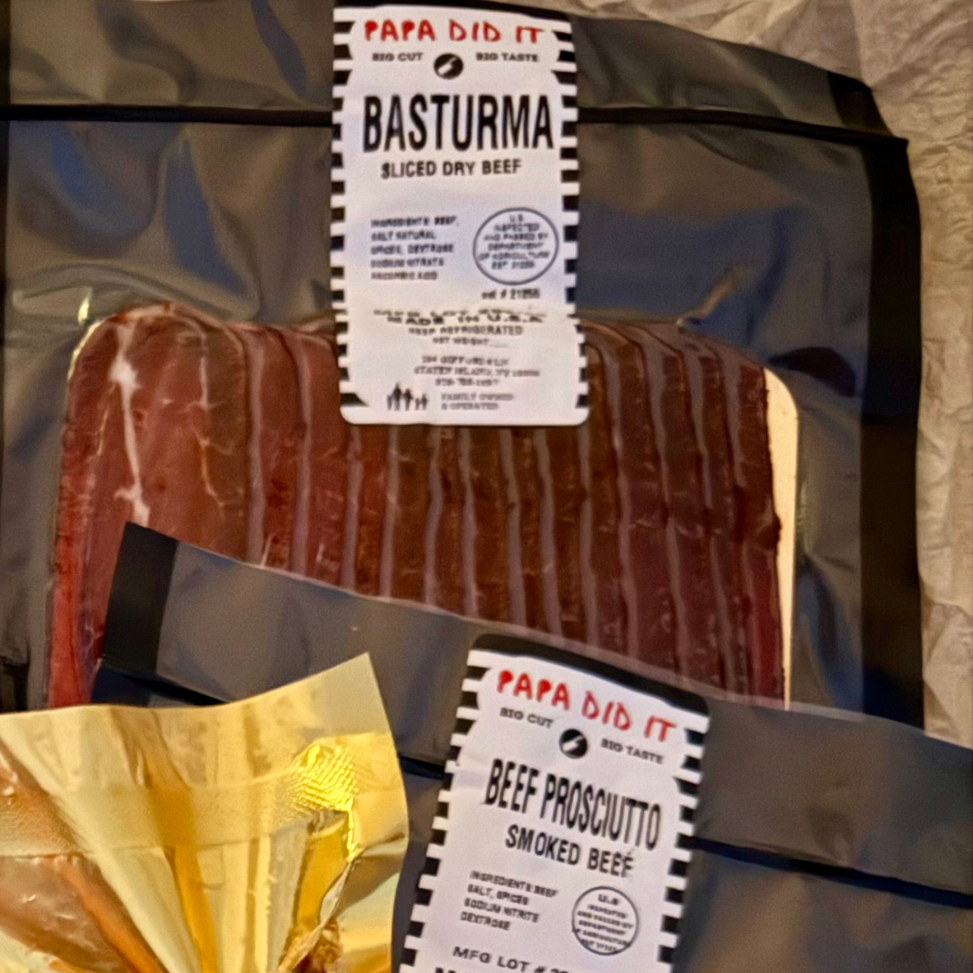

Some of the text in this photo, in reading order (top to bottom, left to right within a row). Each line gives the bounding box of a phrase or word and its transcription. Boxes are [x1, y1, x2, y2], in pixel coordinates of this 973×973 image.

[365, 19, 545, 43] PAPA DID IT
[372, 53, 424, 61] BIG CUT
[476, 53, 539, 62] BIG TASTE
[363, 94, 554, 152] BASTURMA
[381, 159, 522, 179] SLICED DRY BEEF
[440, 326, 523, 335] REFRIGERATED
[497, 670, 675, 742] PAPA DID IT
[500, 707, 554, 728] BIG CUT
[600, 738, 664, 764] BIG TASTE
[484, 758, 661, 850] BEEF PROSCIUTTO
[505, 824, 634, 877] SMOKED BEEF
[461, 911, 510, 930] DEXTROSE
[464, 898, 539, 923] SODIUM NITRITE
[453, 946, 490, 963] MFG
[497, 956, 530, 973] LOT
